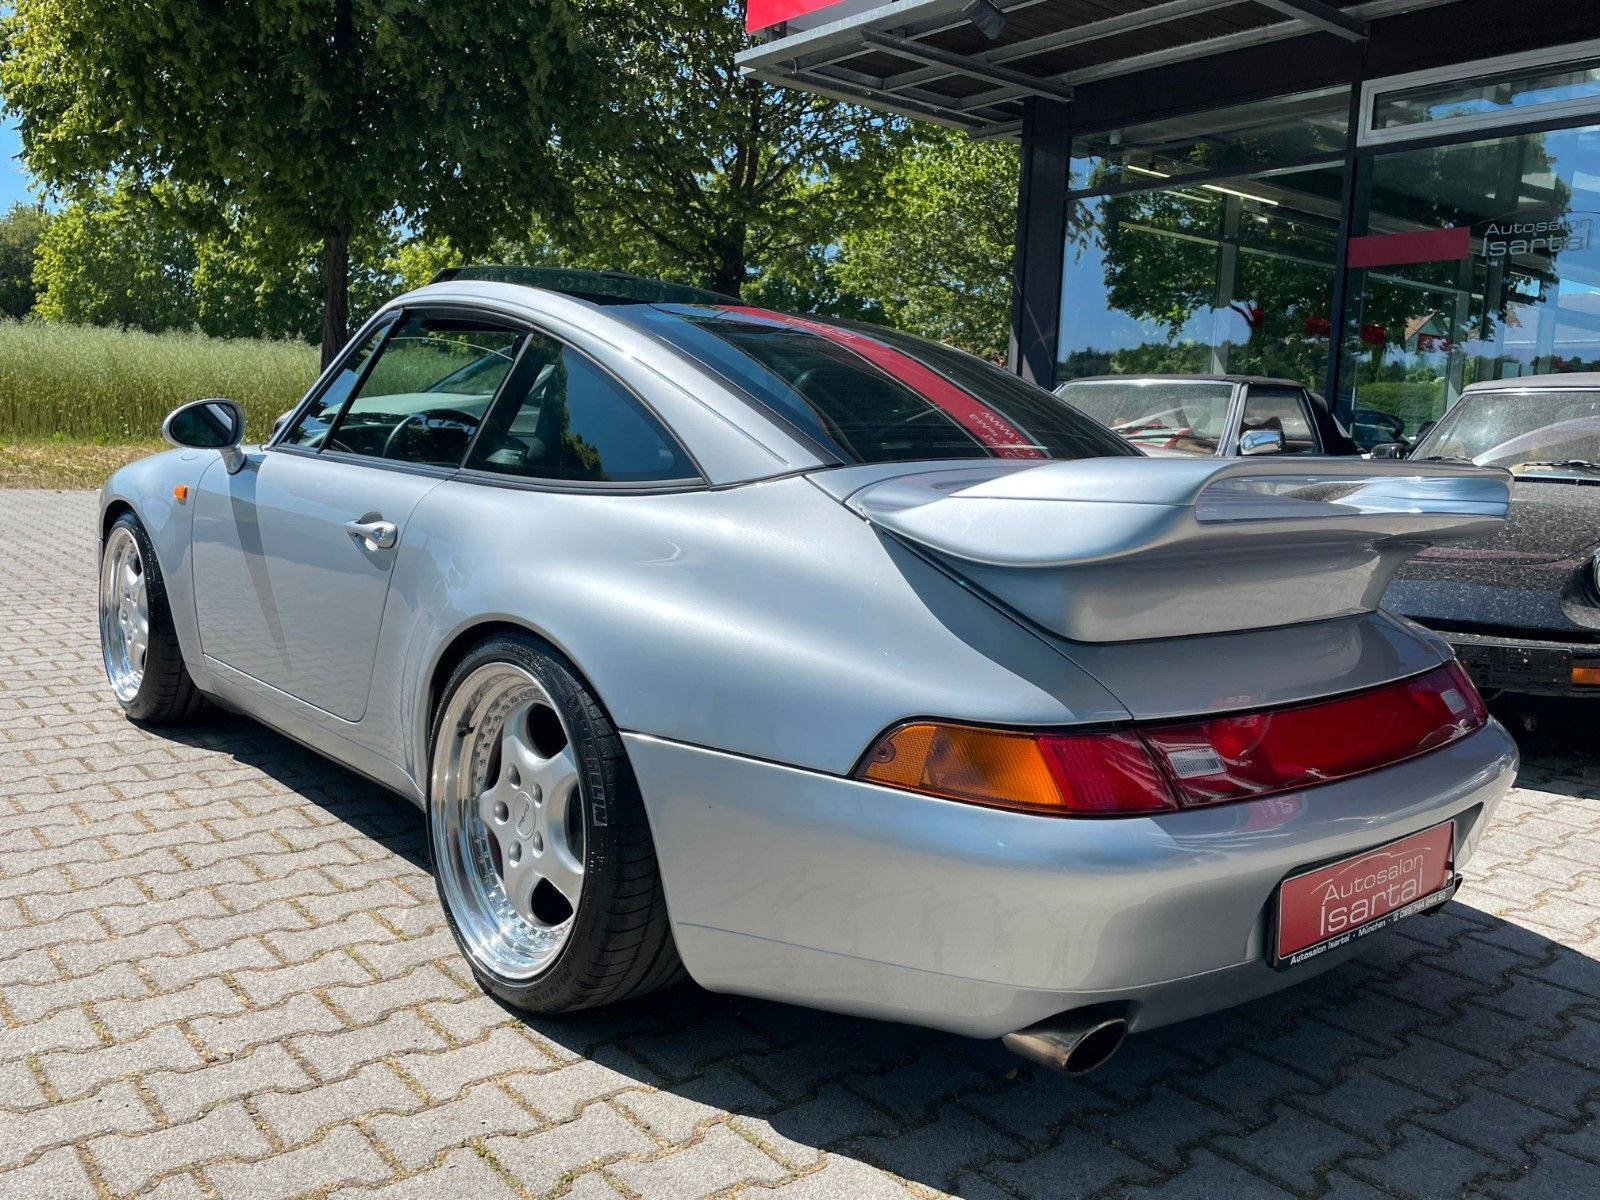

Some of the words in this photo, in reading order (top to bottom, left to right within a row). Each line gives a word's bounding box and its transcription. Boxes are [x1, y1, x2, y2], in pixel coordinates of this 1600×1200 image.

[1481, 229, 1593, 257] Isartal
[1484, 219, 1593, 237] Autosalon
[1319, 867, 1424, 936] Isartal
[1321, 854, 1424, 906] Autosalon
[1290, 945, 1327, 965] Autosalon
[1328, 934, 1351, 949] Isartal
[1358, 919, 1386, 938] München
